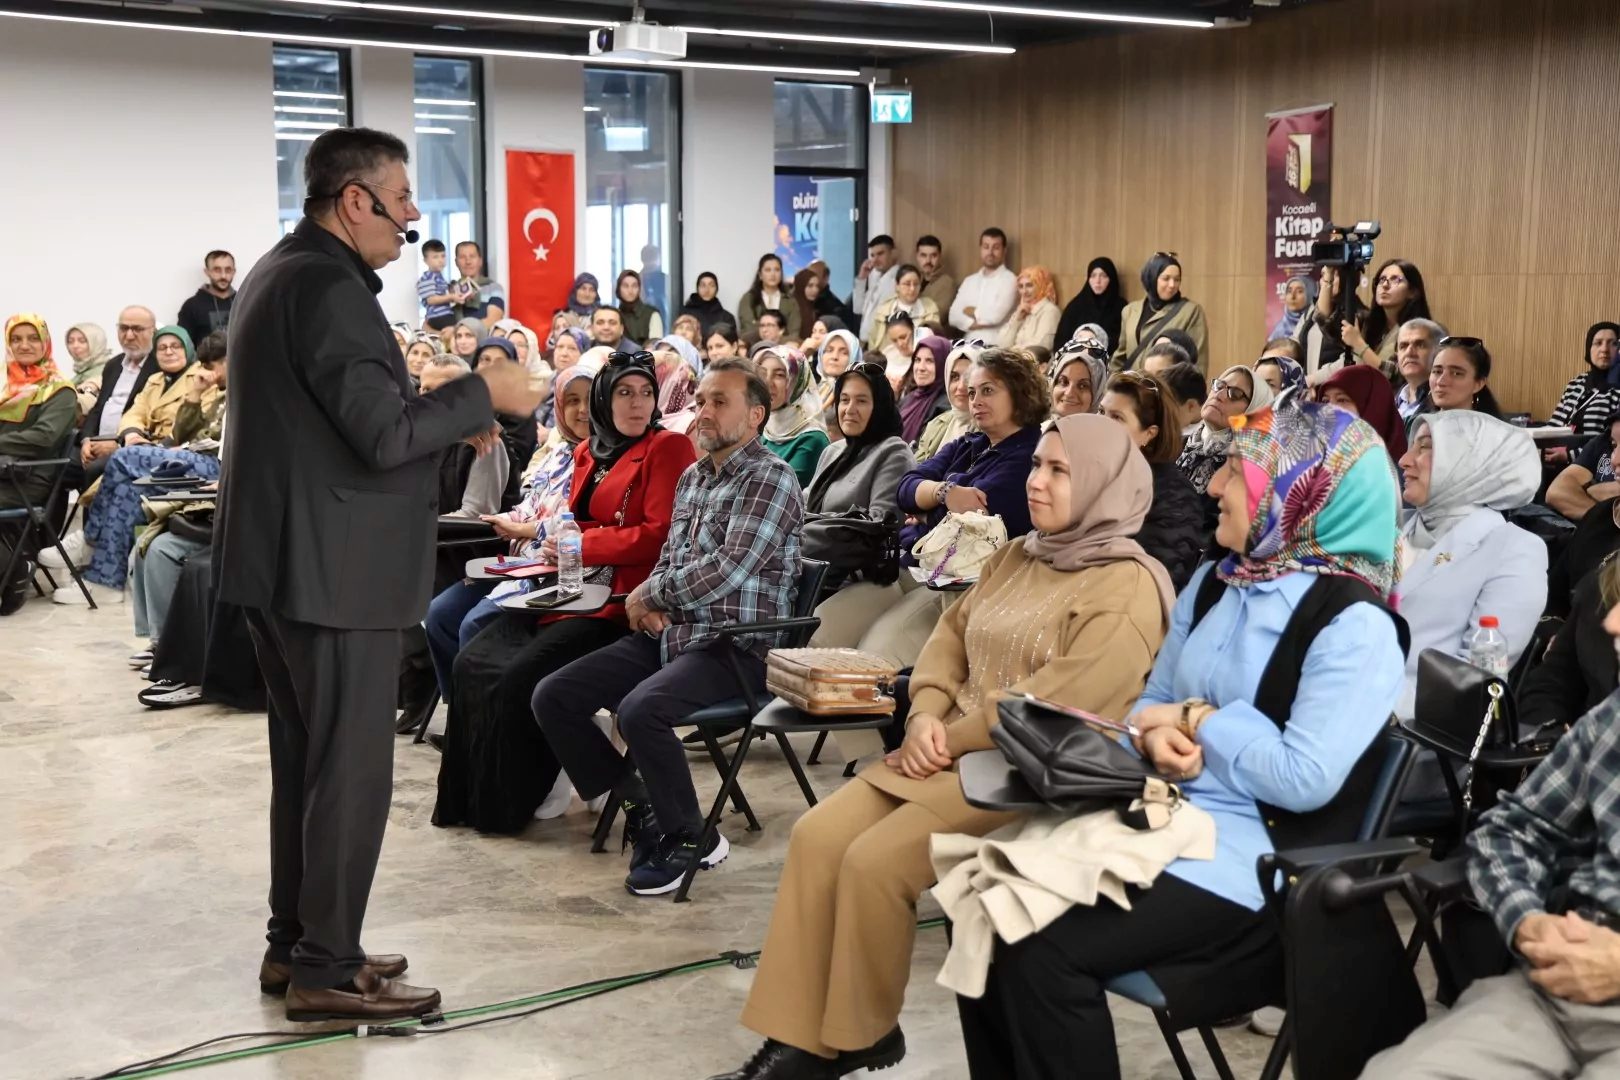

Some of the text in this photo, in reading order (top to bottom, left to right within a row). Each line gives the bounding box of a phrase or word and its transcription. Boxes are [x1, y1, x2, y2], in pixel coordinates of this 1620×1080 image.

[1282, 202, 1317, 215] Kocaeli
[1275, 216, 1323, 238] Kitap
[1275, 238, 1319, 258] Fuar
